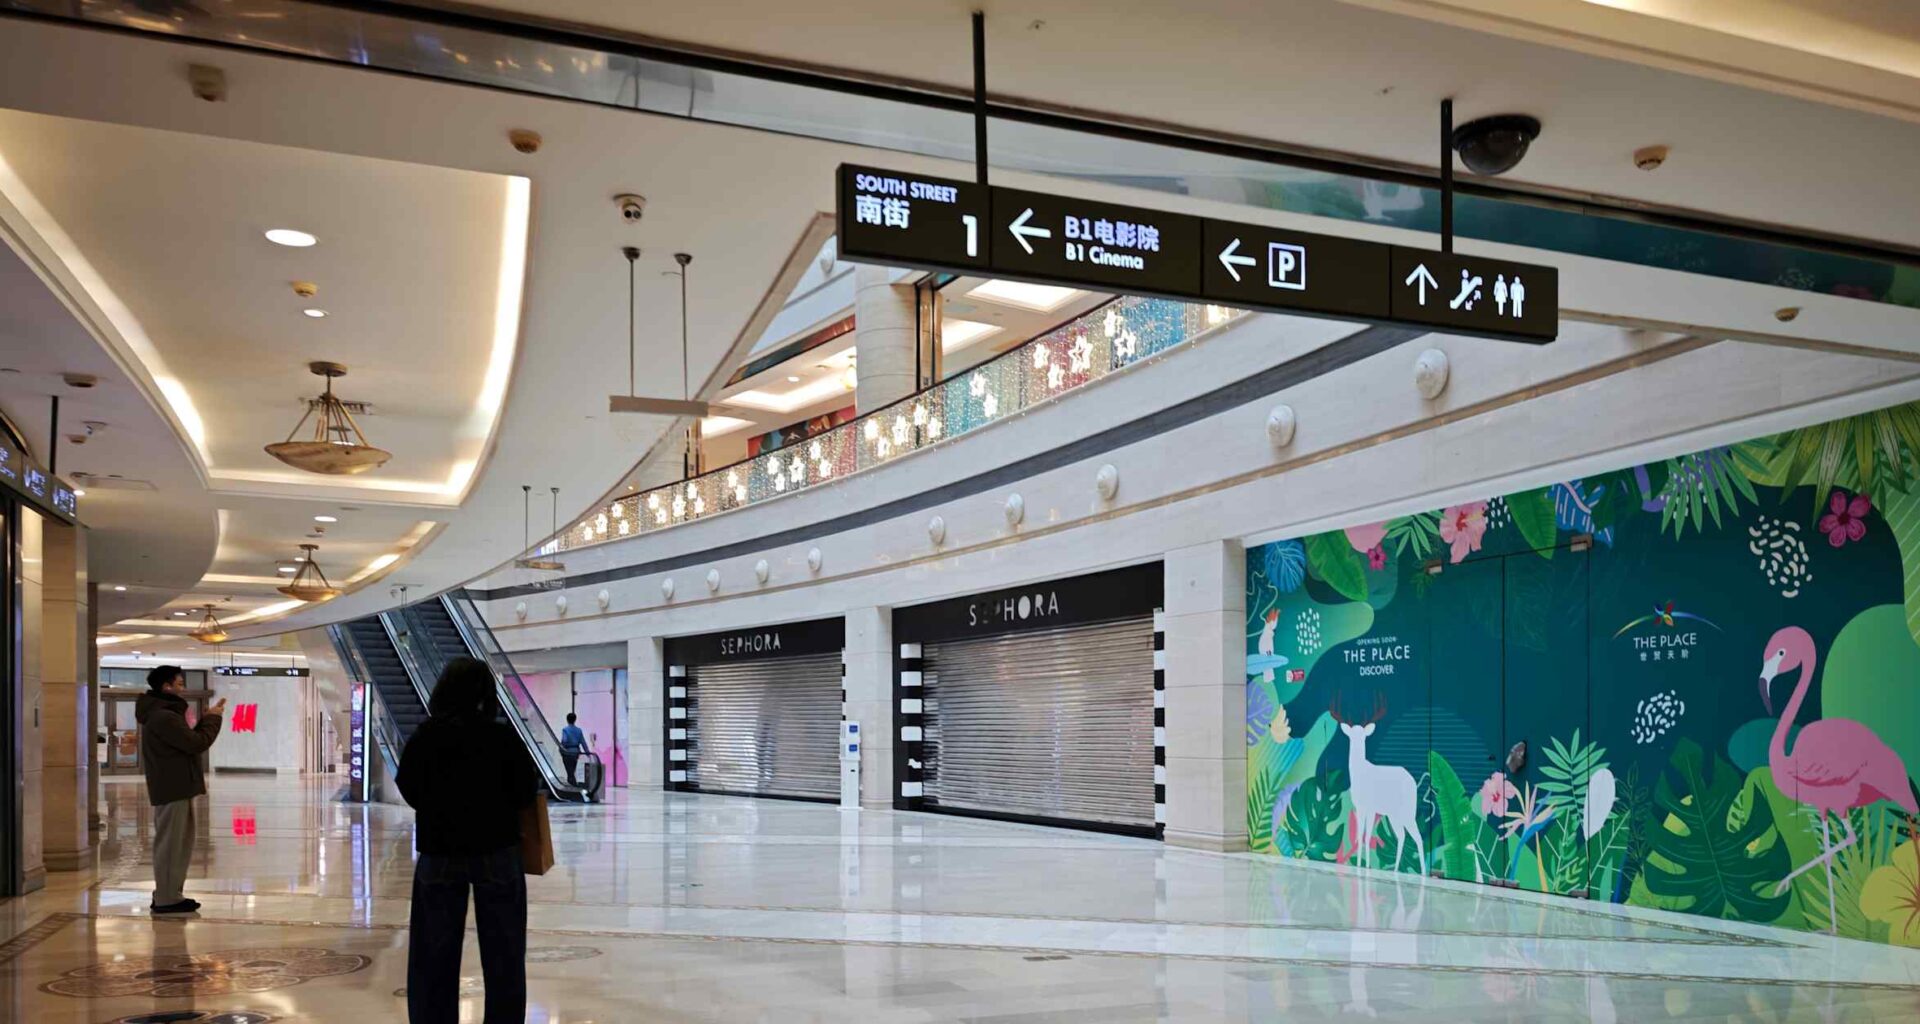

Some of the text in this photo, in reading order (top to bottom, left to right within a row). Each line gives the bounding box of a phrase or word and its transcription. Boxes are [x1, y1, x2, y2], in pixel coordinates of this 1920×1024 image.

[856, 174, 958, 203] SOUTH STREET
[856, 194, 911, 229] 南街
[962, 215, 978, 257] 1
[1065, 215, 1160, 252] B1电影院
[1065, 242, 1144, 270] B1 Cinema
[969, 591, 1059, 627] SHORA
[721, 632, 781, 655] SEPHORA
[1343, 644, 1411, 663] THE PLACE
[1633, 632, 1697, 649] THE PLACE
[1359, 664, 1395, 676] DISCOVER
